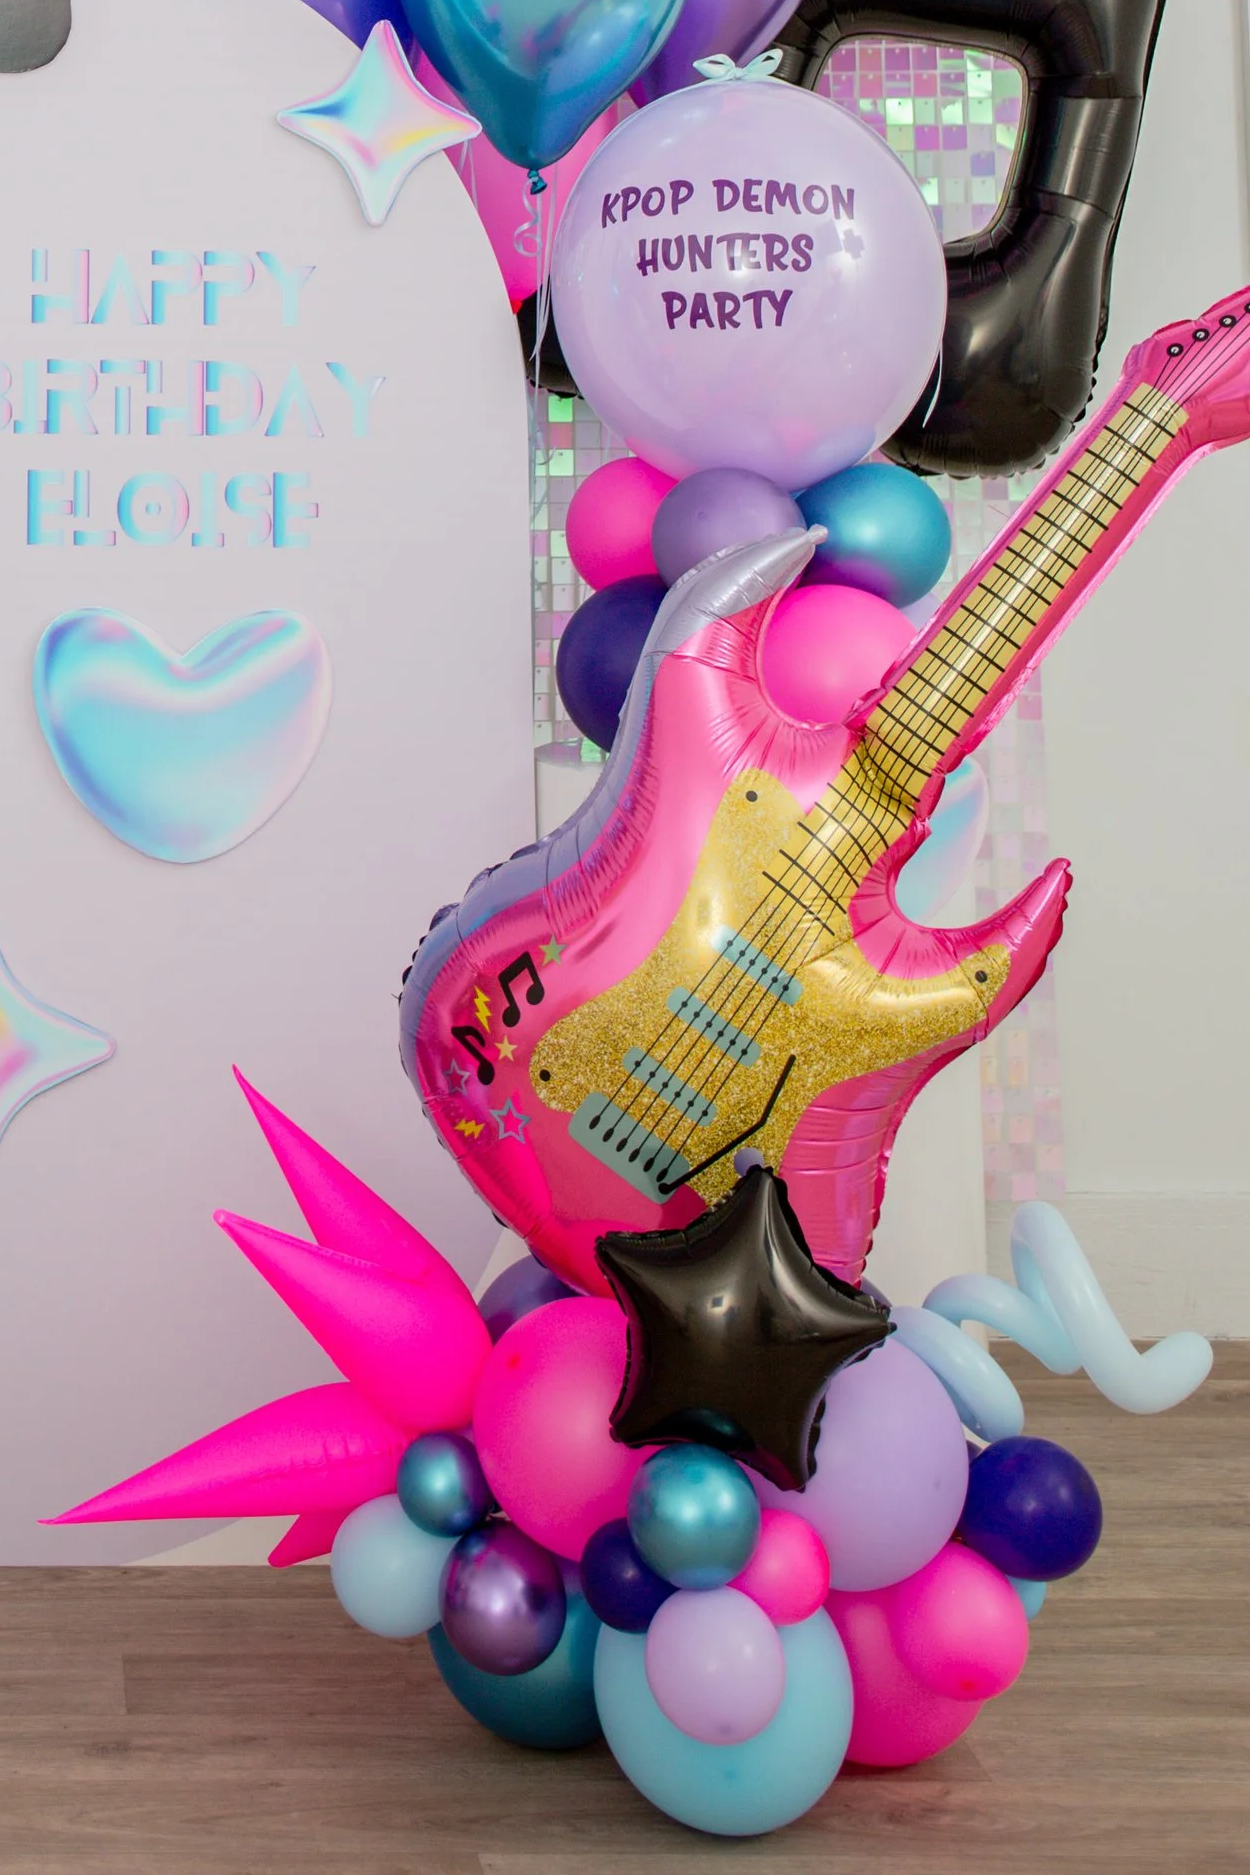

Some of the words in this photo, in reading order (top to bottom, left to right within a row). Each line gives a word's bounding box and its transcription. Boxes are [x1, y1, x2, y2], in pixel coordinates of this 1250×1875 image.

[601, 179, 695, 228] KPOP
[712, 178, 855, 220] DEMON
[636, 232, 814, 276] HUNTERS
[31, 248, 317, 327] HAPPY
[661, 289, 793, 330] PARTY
[26, 469, 320, 549] ELOISE
